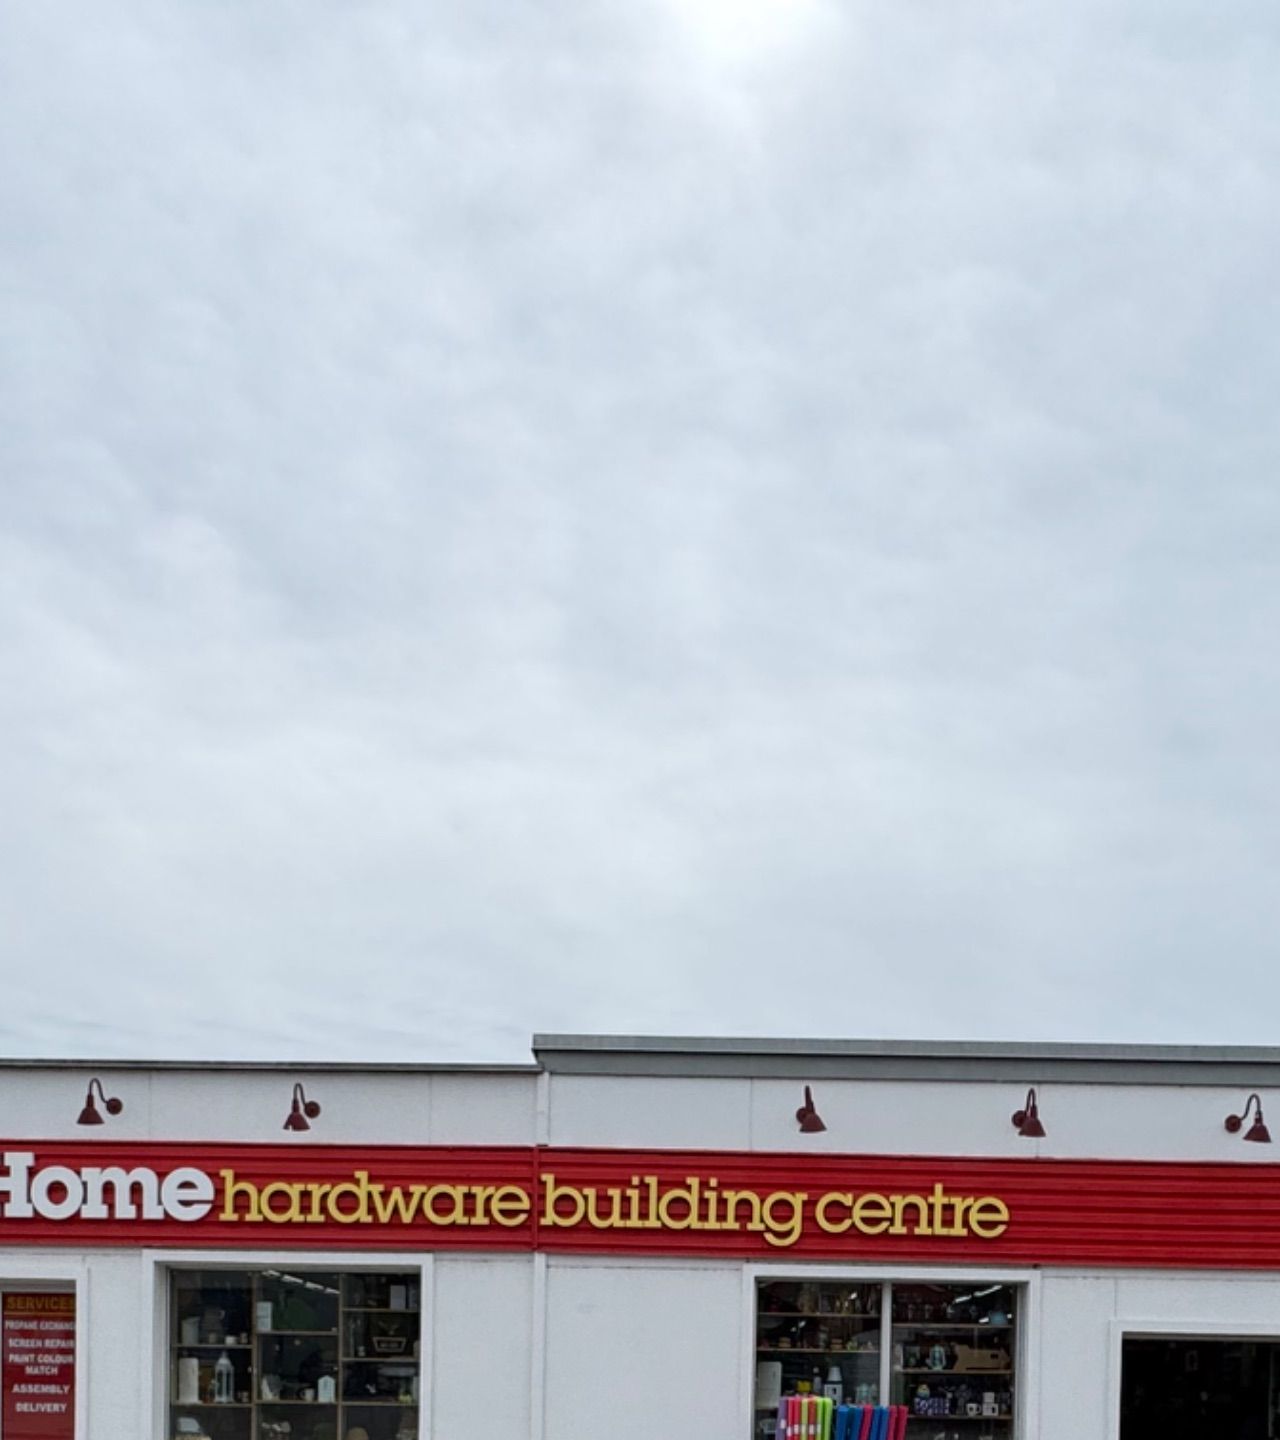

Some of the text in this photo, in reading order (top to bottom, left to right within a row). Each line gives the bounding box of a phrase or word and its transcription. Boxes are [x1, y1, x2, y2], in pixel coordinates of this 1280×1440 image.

[218, 1168, 531, 1227] hardware
[540, 1173, 808, 1247] building
[815, 1182, 1010, 1239] centre
[8, 1353, 35, 1364] PAINT
[25, 1365, 58, 1376] MATCH
[12, 1383, 70, 1395] ASSEMBLY
[15, 1402, 67, 1413] DELIVERY
